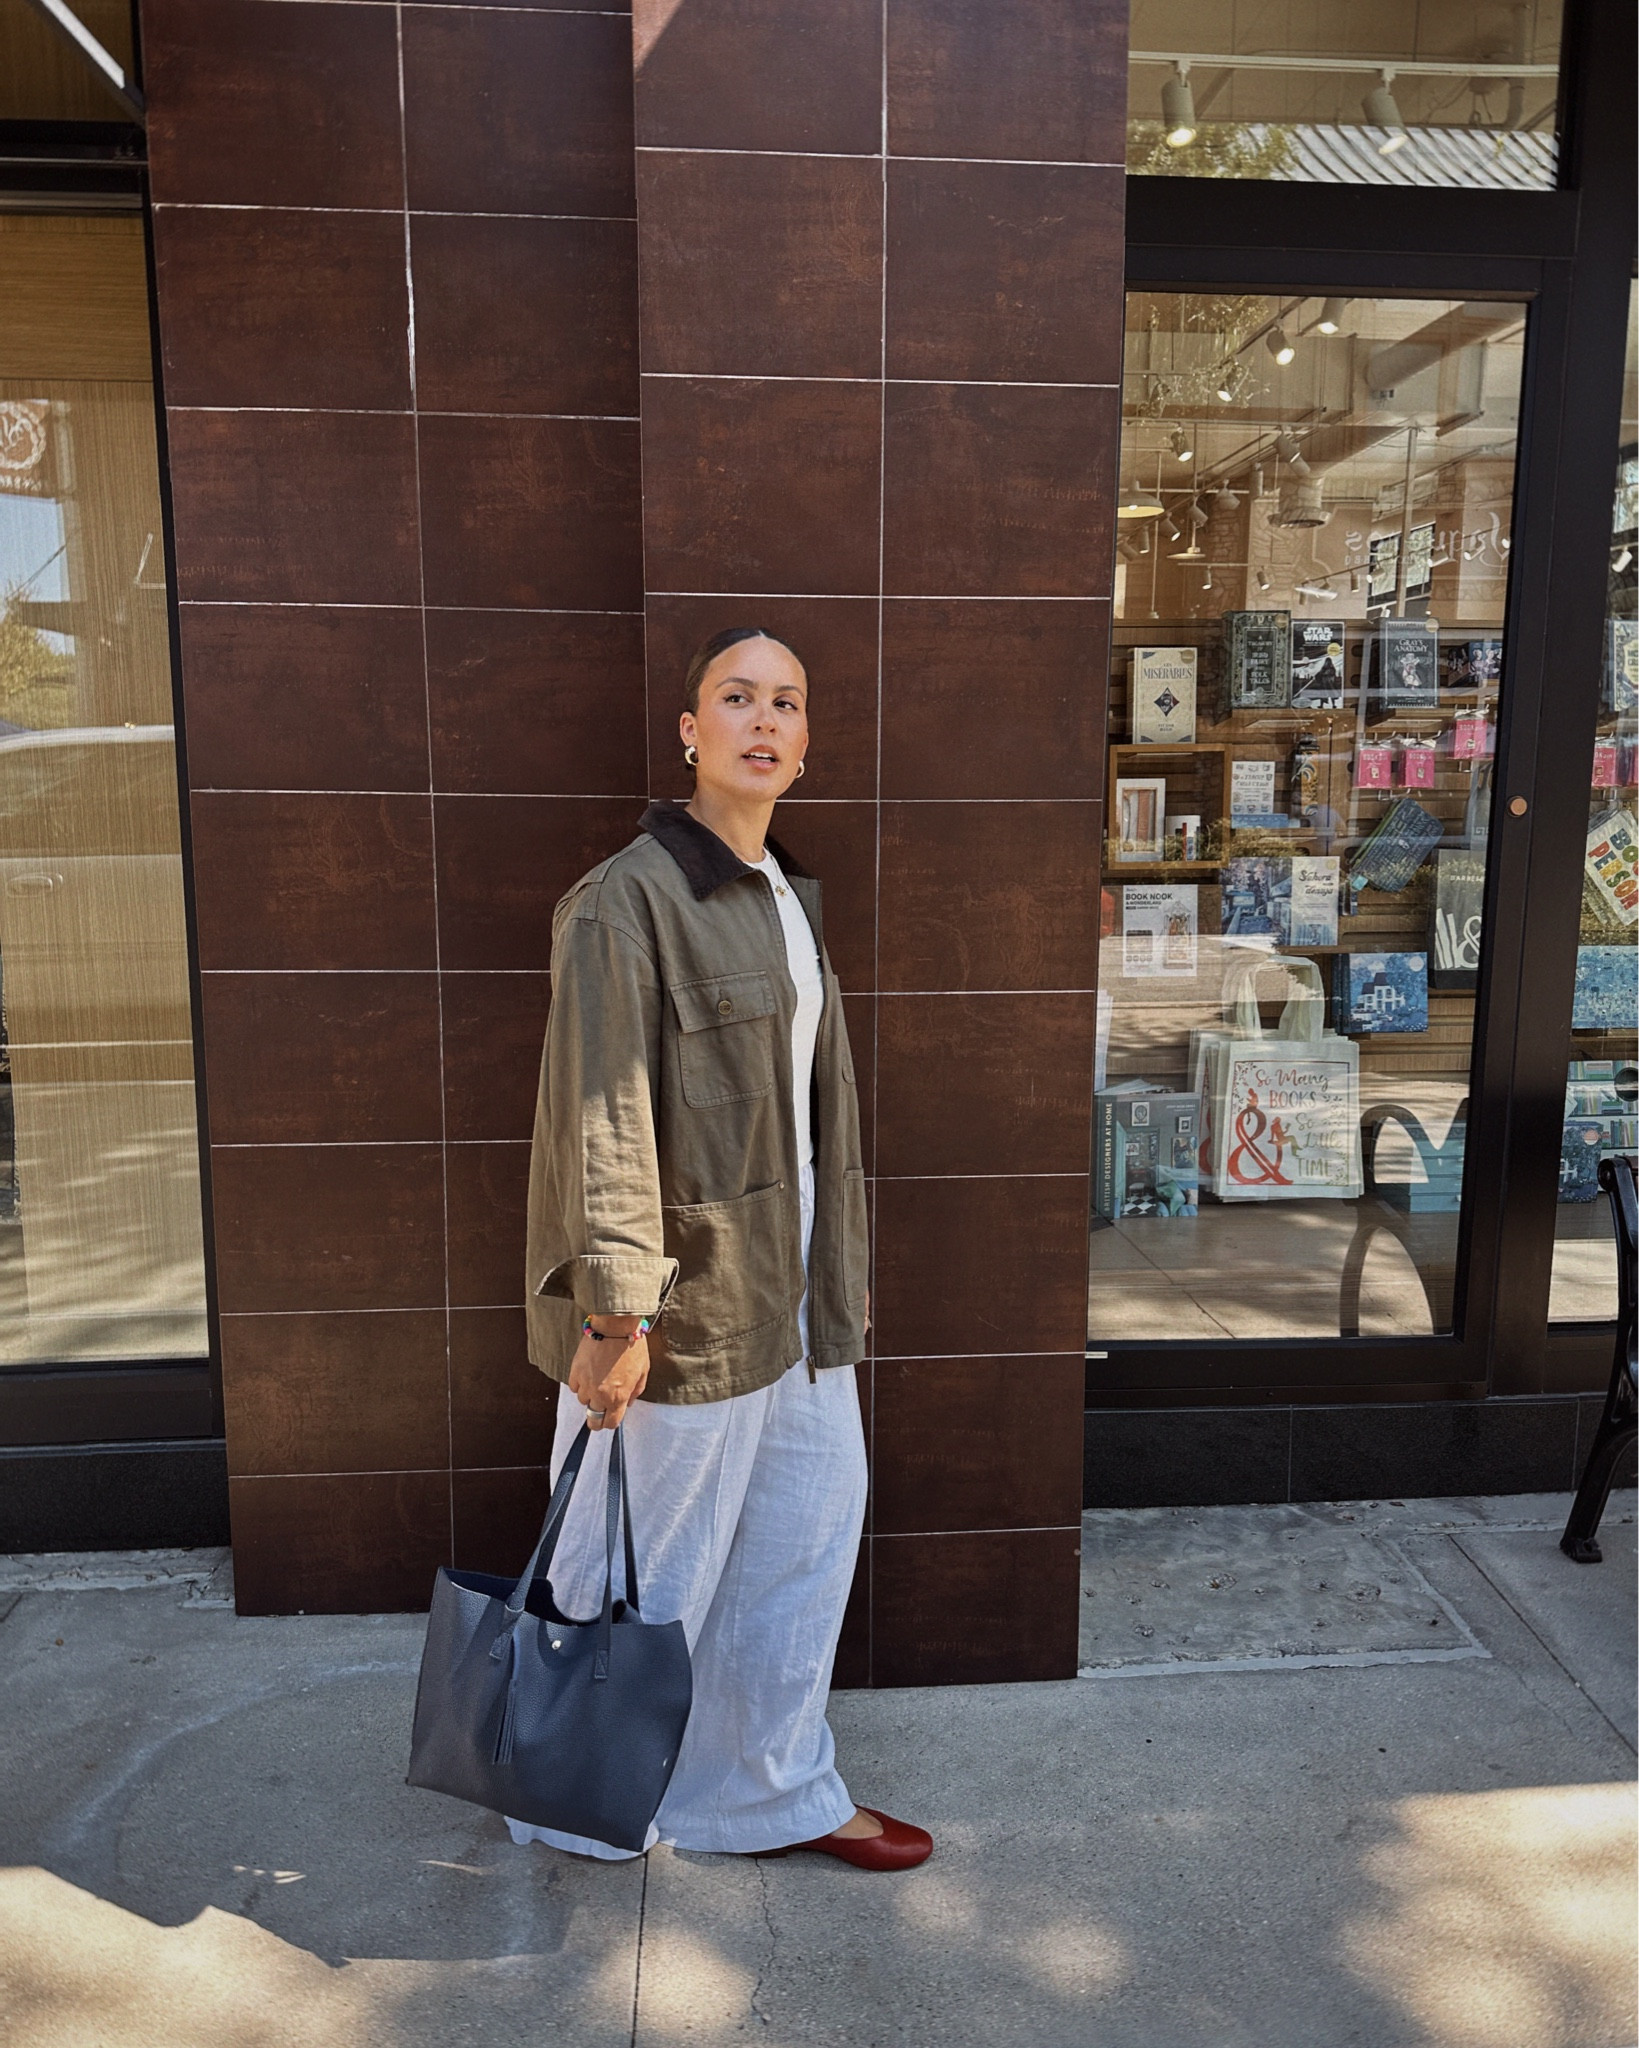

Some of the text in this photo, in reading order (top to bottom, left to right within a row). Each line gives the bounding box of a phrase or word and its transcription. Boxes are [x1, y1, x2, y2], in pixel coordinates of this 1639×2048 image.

[1303, 626, 1333, 635] STAR
[1303, 633, 1333, 642] WARS
[1394, 644, 1429, 653] ANATOMY
[1587, 840, 1638, 911] PERSON
[1255, 1068, 1329, 1092] So Many
[1269, 1089, 1317, 1109] BOOKS
[1105, 1103, 1113, 1126] HOME
[1295, 1112, 1315, 1131] So
[1105, 1127, 1112, 1136] AT
[1227, 1107, 1294, 1186] &
[1104, 1138, 1112, 1180] DESIGNERS
[1296, 1157, 1333, 1177] TIME
